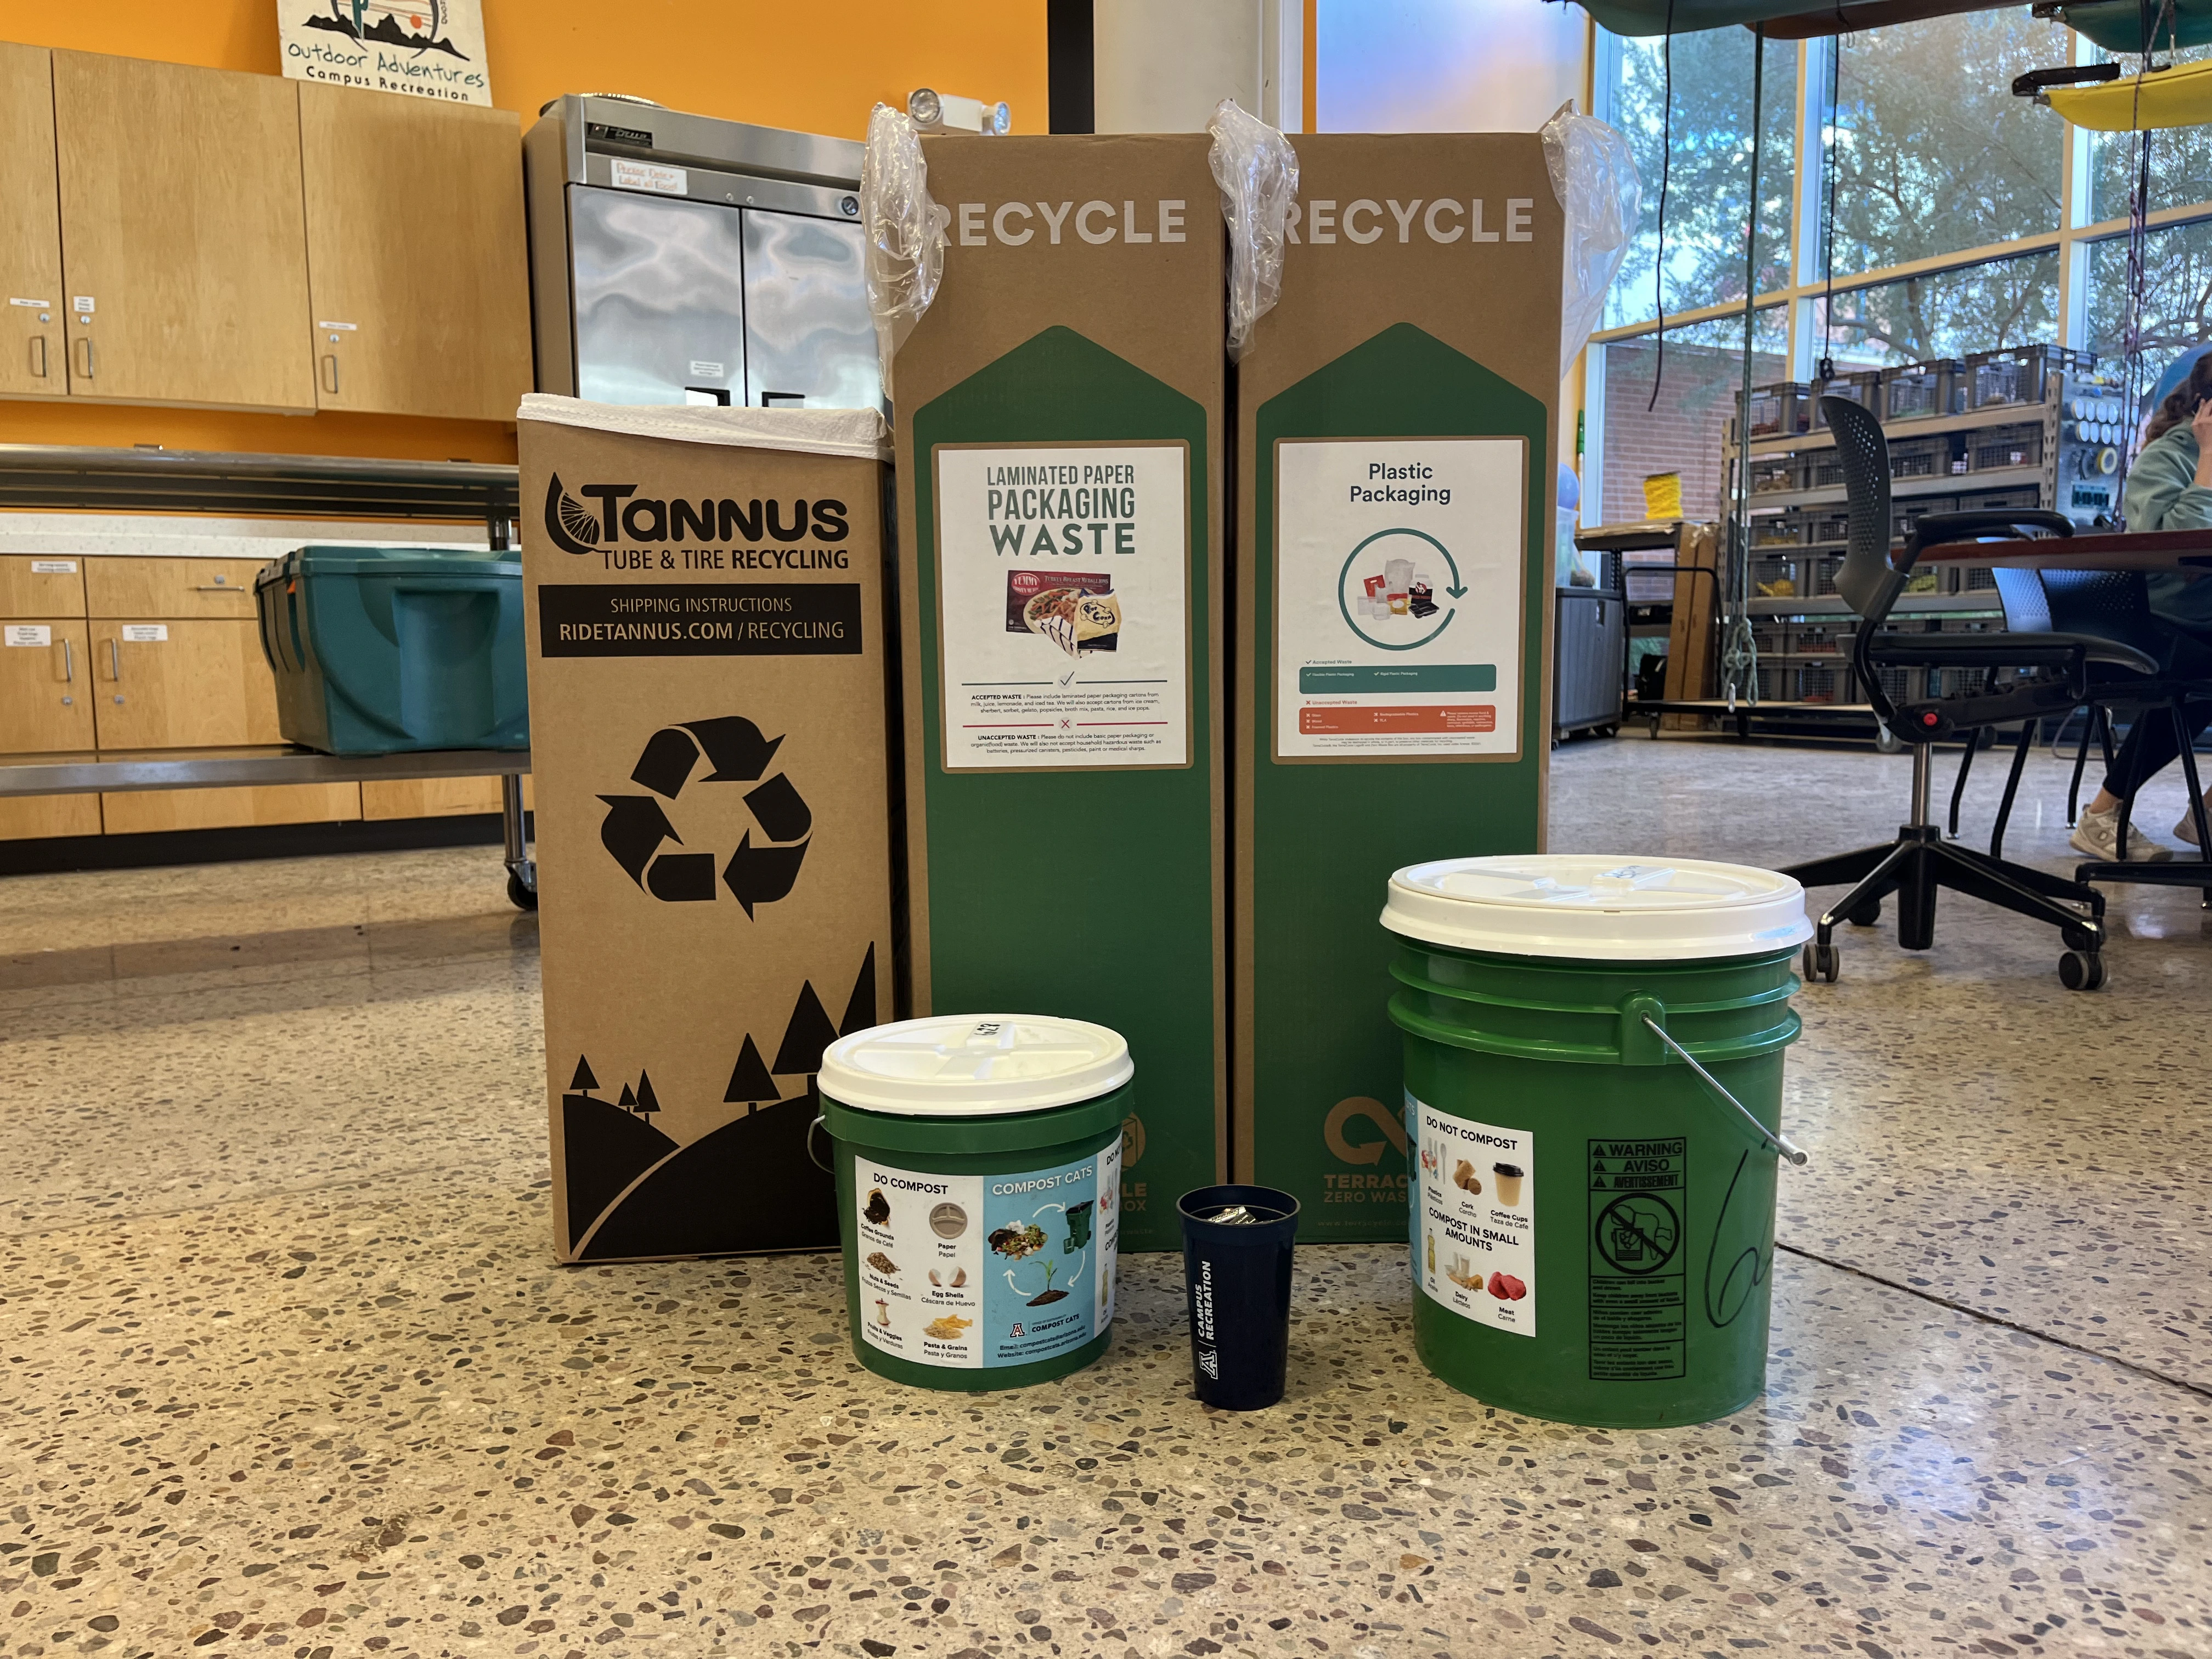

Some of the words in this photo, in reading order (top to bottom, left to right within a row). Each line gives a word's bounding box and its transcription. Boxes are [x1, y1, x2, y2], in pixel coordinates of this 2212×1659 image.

[289, 43, 368, 67] Outdoor
[377, 52, 484, 88] Adventures
[306, 66, 370, 86] Campus
[379, 77, 469, 101] Recreation
[928, 200, 1186, 246] RECYCLE
[1283, 198, 1533, 245] RECYCLE
[987, 466, 1079, 486] LAMINATED
[1084, 465, 1135, 484] PAPER
[1369, 462, 1433, 479] Plastic
[988, 487, 1135, 520] PACKAGING
[1350, 484, 1451, 506] Packaging
[989, 523, 1135, 556] WASTE
[604, 550, 653, 570] TUBE
[660, 550, 675, 569] &
[685, 550, 724, 569] TIRE
[732, 549, 849, 569] RECYCLING
[611, 598, 680, 613] SHIPPING
[686, 597, 792, 612] INSTRUCTIONS
[1426, 1115, 1437, 1128] DO
[1440, 1121, 1458, 1136] NOT
[1460, 1129, 1517, 1150] COMPOST
[1107, 1153, 1114, 1165] DO
[1608, 1142, 1683, 1156] WARNING
[1623, 1159, 1669, 1172] AVISO
[873, 1172, 888, 1185] DO
[890, 1178, 949, 1194] COMPOST
[992, 1175, 1062, 1195] COMPOST
[1065, 1165, 1092, 1184] CATS
[1323, 1174, 1408, 1189] TERRAC
[1323, 1191, 1365, 1203] ZERO
[1370, 1191, 1407, 1203] WAS
[1461, 1201, 1474, 1210] Cork
[1490, 1216, 1504, 1225] Taza
[1491, 1210, 1510, 1219] Coffee
[1511, 1214, 1528, 1222] Cups
[1429, 1207, 1468, 1232] COMPOST
[1470, 1224, 1480, 1237] IN
[1482, 1229, 1519, 1246] SMALL
[1445, 1227, 1492, 1251] AMOUNTS
[921, 1296, 945, 1305] Cáscara
[1201, 1261, 1215, 1341] RECREATION
[1455, 1291, 1469, 1302] Dairy
[1195, 1284, 1205, 1338] CAMPUS
[1498, 1313, 1515, 1323] Carne
[1499, 1306, 1515, 1316] Meat
[1031, 1319, 1064, 1333] COMPOST
[1065, 1313, 1080, 1324] CATS
[924, 1349, 940, 1357] Pasta
